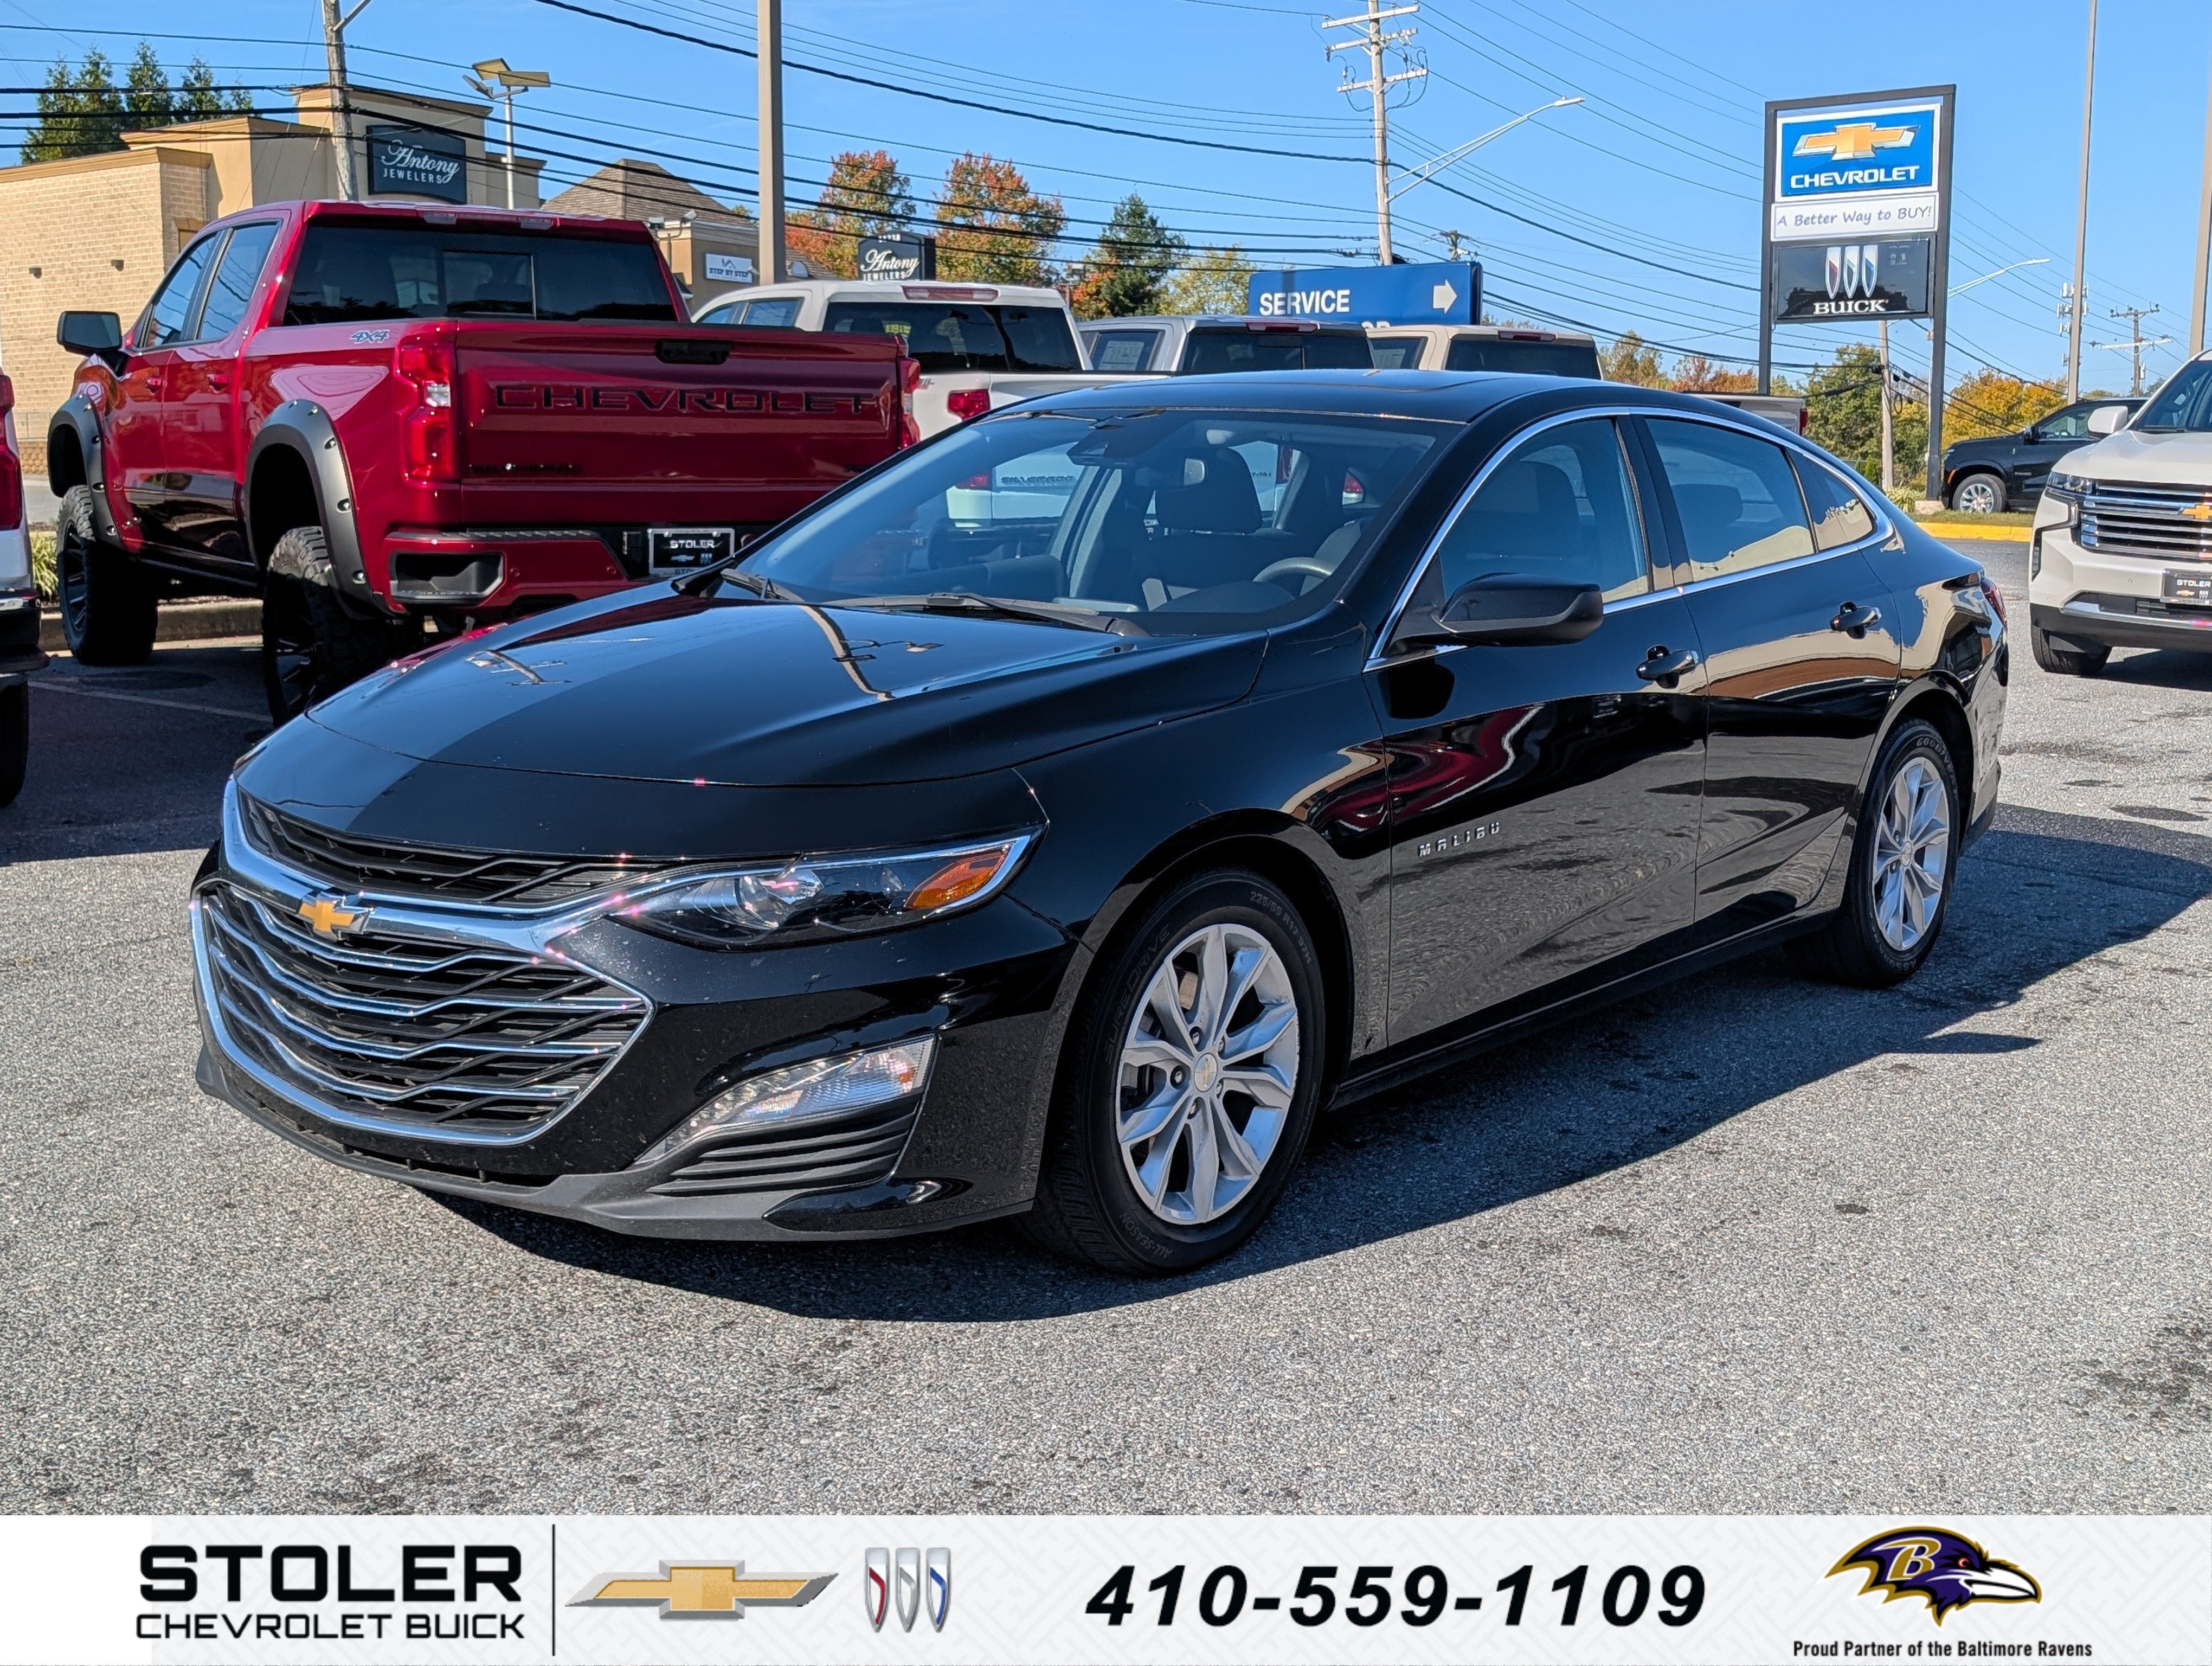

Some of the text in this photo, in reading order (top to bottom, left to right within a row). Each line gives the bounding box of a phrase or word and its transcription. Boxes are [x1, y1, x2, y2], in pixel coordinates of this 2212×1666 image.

[381, 139, 460, 183] Antony
[383, 168, 442, 184] JEWELERS
[1791, 165, 1920, 188] CHEVROLET
[1777, 206, 1932, 226] A Better Way to BUY!
[860, 249, 920, 278] Antony
[863, 271, 906, 281] JEWELERS
[1259, 289, 1351, 316] SERVICE
[1813, 299, 1887, 315] BUICK
[494, 385, 874, 414] CHEVROLET
[670, 540, 715, 549] STOLER
[2176, 579, 2211, 587] STOLER
[1418, 821, 1500, 858] MALIBU
